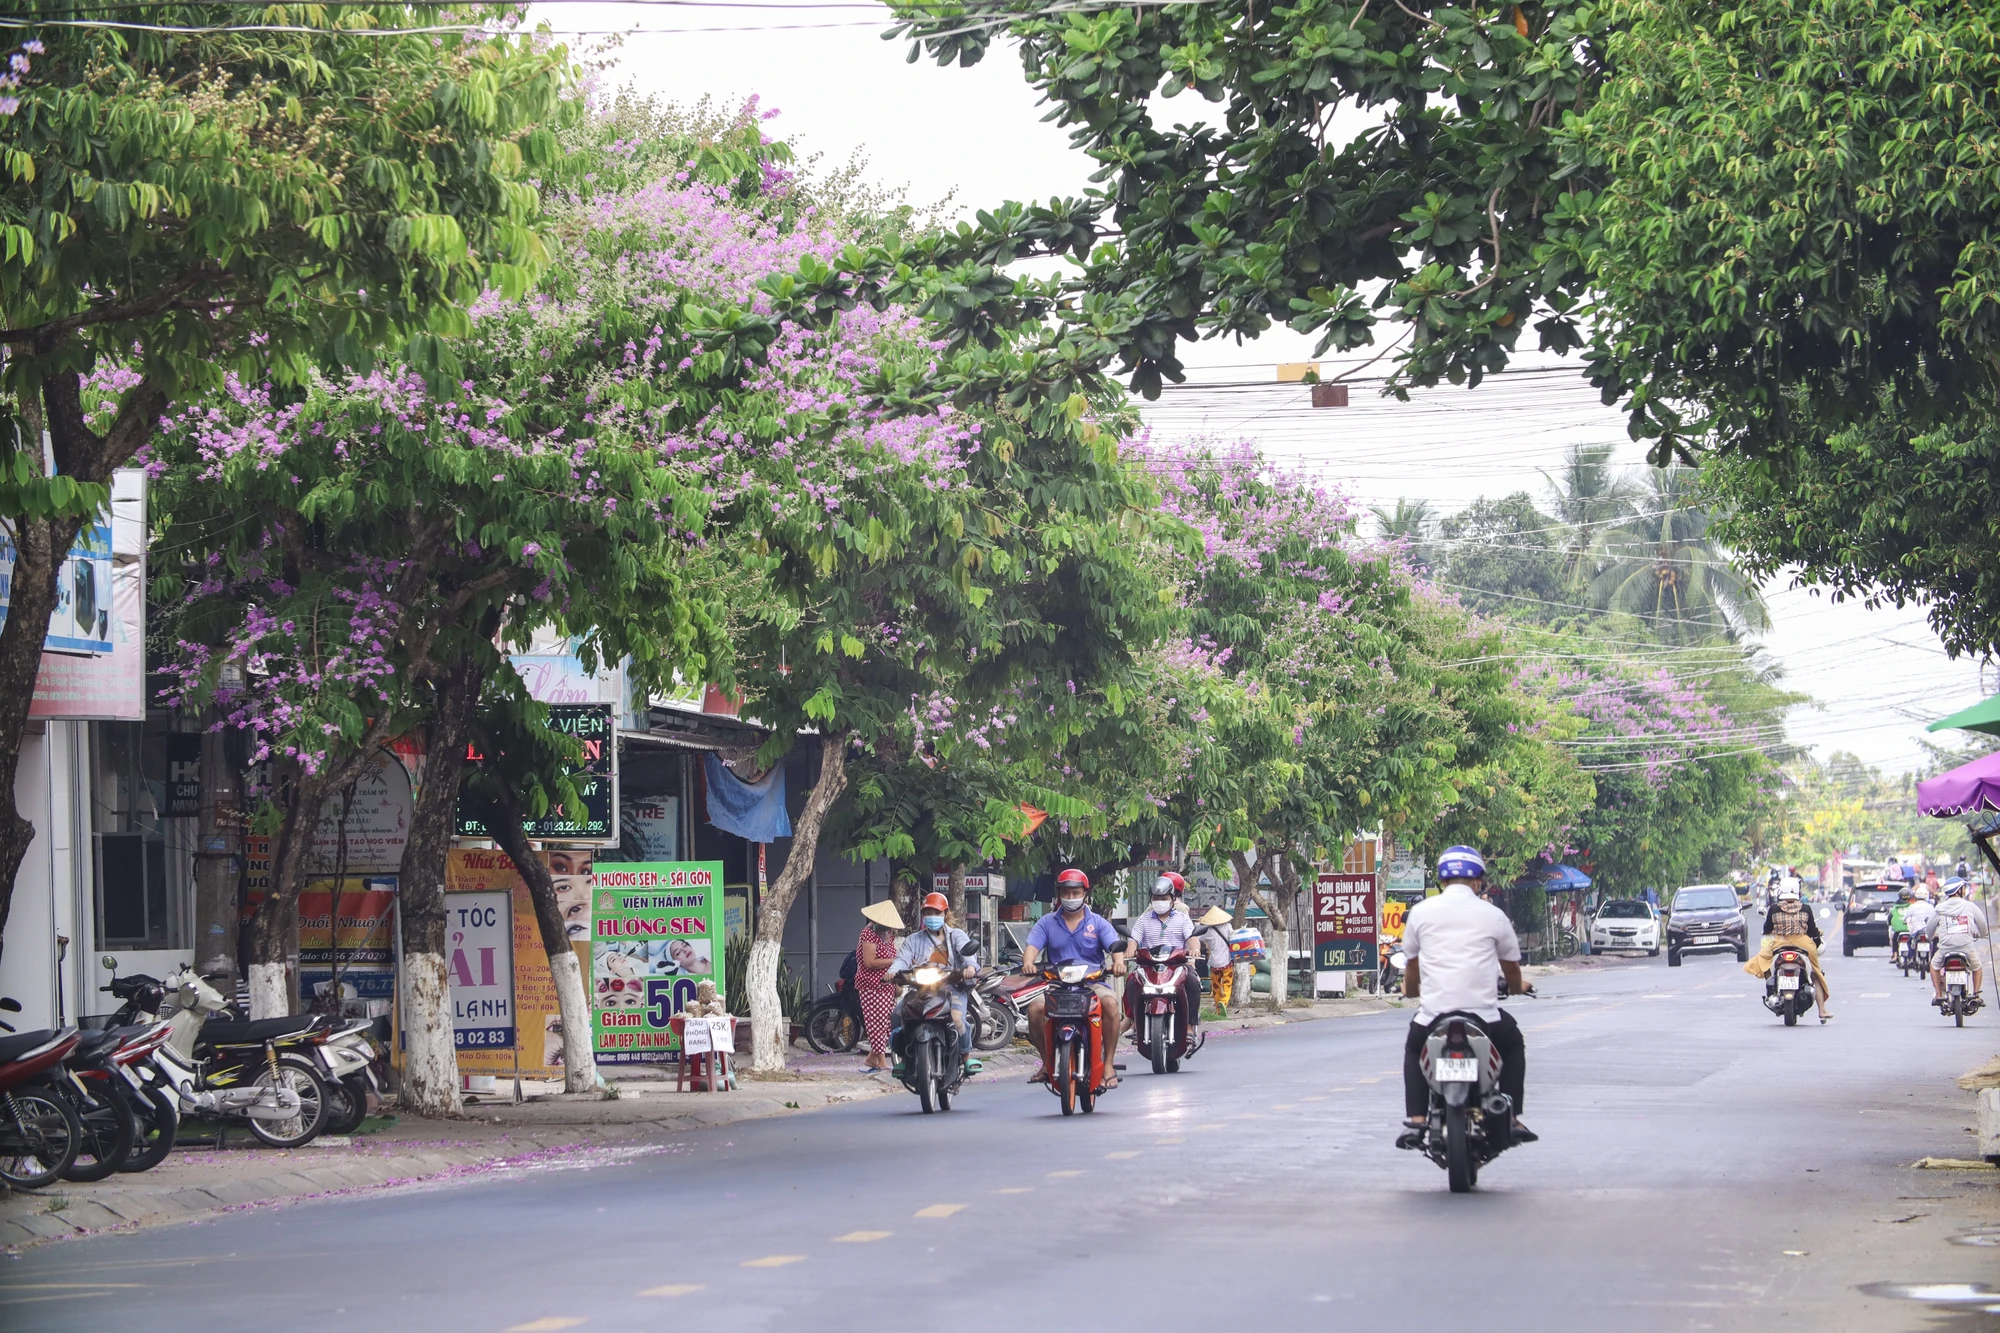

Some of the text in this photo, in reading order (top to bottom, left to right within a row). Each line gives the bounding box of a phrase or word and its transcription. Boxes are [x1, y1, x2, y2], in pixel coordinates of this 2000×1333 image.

[560, 714, 604, 735] VIỆN
[176, 785, 200, 797] CHU
[601, 870, 636, 887] HƯƠNG
[639, 872, 658, 885] SEN
[670, 868, 687, 886] SÀI
[690, 868, 711, 885] GÒN
[1317, 879, 1370, 894] CƠM BÌNH DÂN
[623, 892, 704, 910] VIỆN THẨM MỸ
[1320, 895, 1367, 915] 25K
[458, 902, 496, 927] TÓC
[598, 916, 706, 936] HƯƠNG SEN
[1316, 921, 1334, 932] CƠM
[368, 951, 387, 960] 020
[456, 999, 507, 1022] LẠNH
[601, 1010, 642, 1026] Giảm
[468, 1032, 485, 1044] 02
[489, 1031, 505, 1042] 83
[600, 1030, 671, 1050] LÀM ĐẸP TẬN NHÀ
